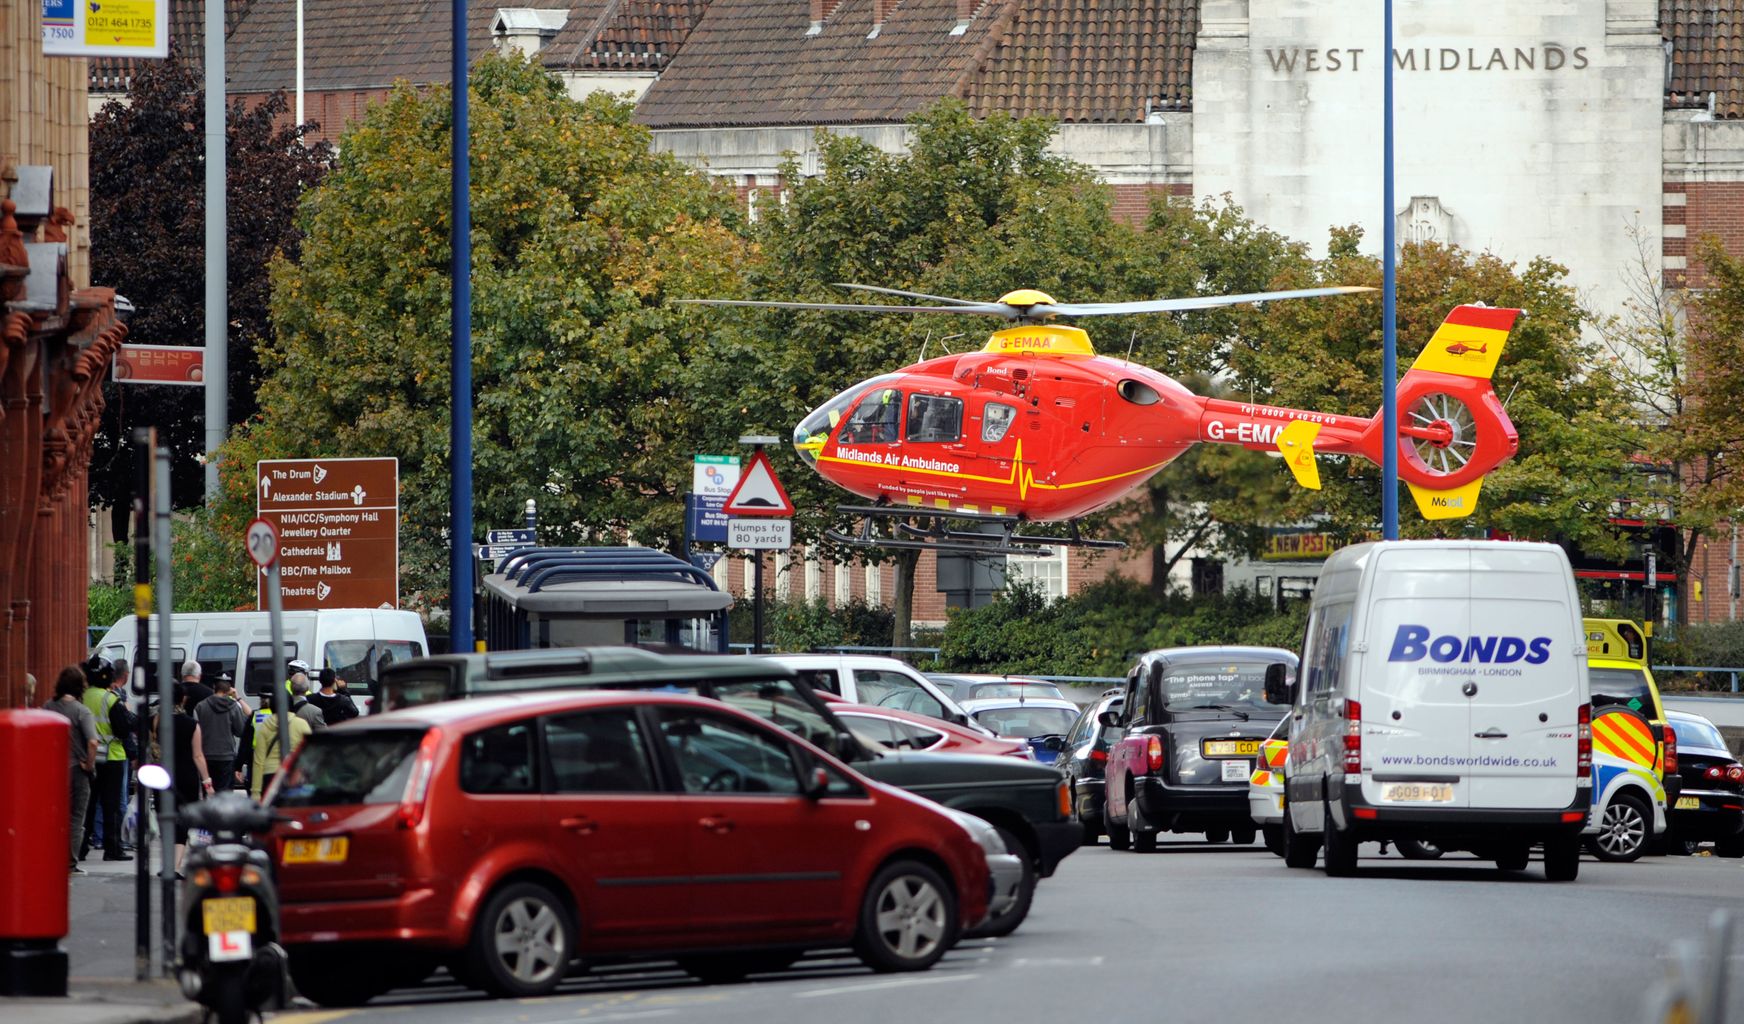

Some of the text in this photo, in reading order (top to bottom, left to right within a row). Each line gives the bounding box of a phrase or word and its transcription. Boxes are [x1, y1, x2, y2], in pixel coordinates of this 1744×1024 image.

[88, 17, 152, 28] 0121 464 1735
[51, 28, 74, 38] 7500
[1265, 47, 1589, 72] WEST MIDLANDS
[1000, 337, 1051, 349] G-EMAA
[126, 350, 193, 360] SOUND
[987, 366, 1008, 375] Bond
[1261, 408, 1284, 417] 0800
[1311, 415, 1322, 423] 20
[1325, 416, 1337, 424] 40
[836, 446, 960, 473] Midlands Air Ambulance
[272, 469, 311, 479] The Drum
[878, 483, 899, 491] Funded
[907, 487, 926, 495] people
[272, 490, 349, 502] Alexander Stadium
[280, 511, 379, 524] NIA/ICC/Symphony Hall
[280, 527, 352, 539] Jewellery Quarter
[733, 523, 785, 533] Humps for
[736, 534, 783, 544] 80 yards
[1277, 536, 1299, 553] NEW
[1302, 535, 1324, 553] PS3
[280, 546, 325, 557] Cathedrals
[281, 565, 352, 577] BBC/The Mailbox
[281, 586, 316, 596] Theatres
[1388, 624, 1552, 664] BONDS
[1418, 667, 1476, 676] BIRMINGHAM
[1187, 675, 1216, 683] phone
[1382, 754, 1557, 767] www.bondsworldwide.co.uk
[220, 932, 239, 950] L
